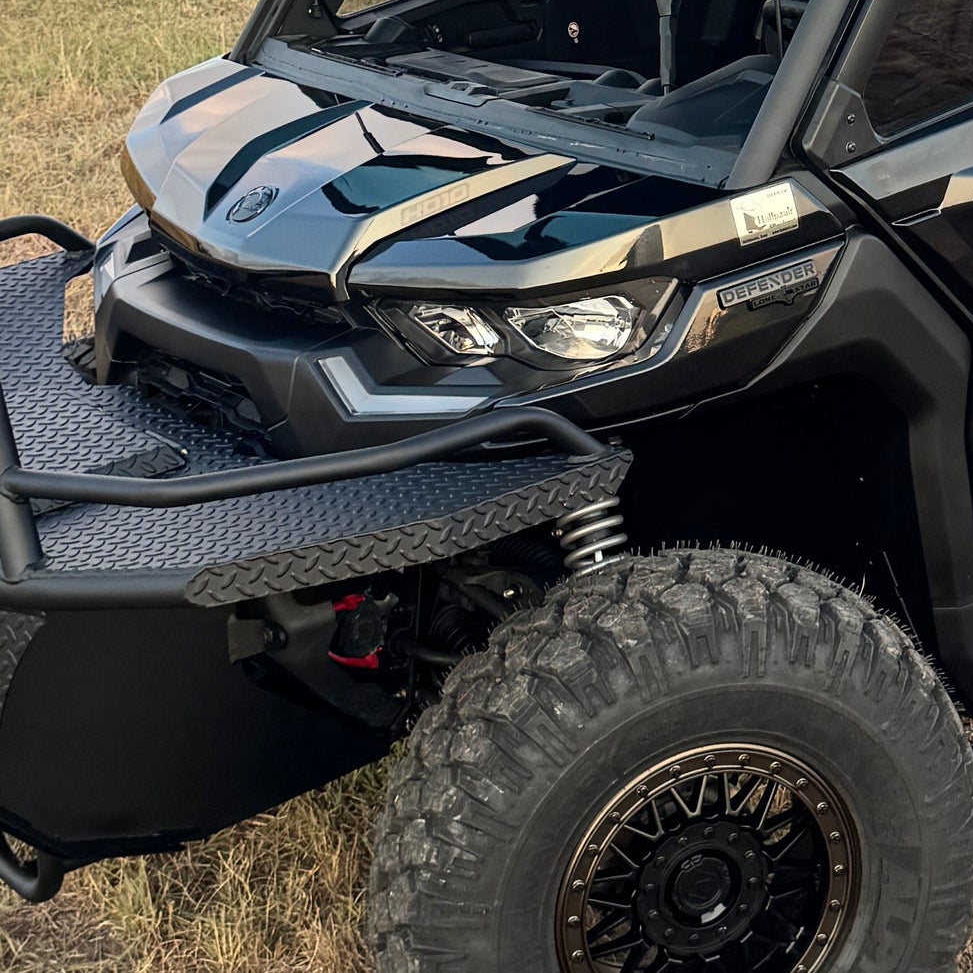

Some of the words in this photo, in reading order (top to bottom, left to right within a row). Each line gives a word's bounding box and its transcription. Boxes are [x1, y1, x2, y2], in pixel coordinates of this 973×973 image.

[721, 262, 816, 304] DEFENDER
[753, 293, 776, 308] LONE
[793, 279, 817, 294] STAR
